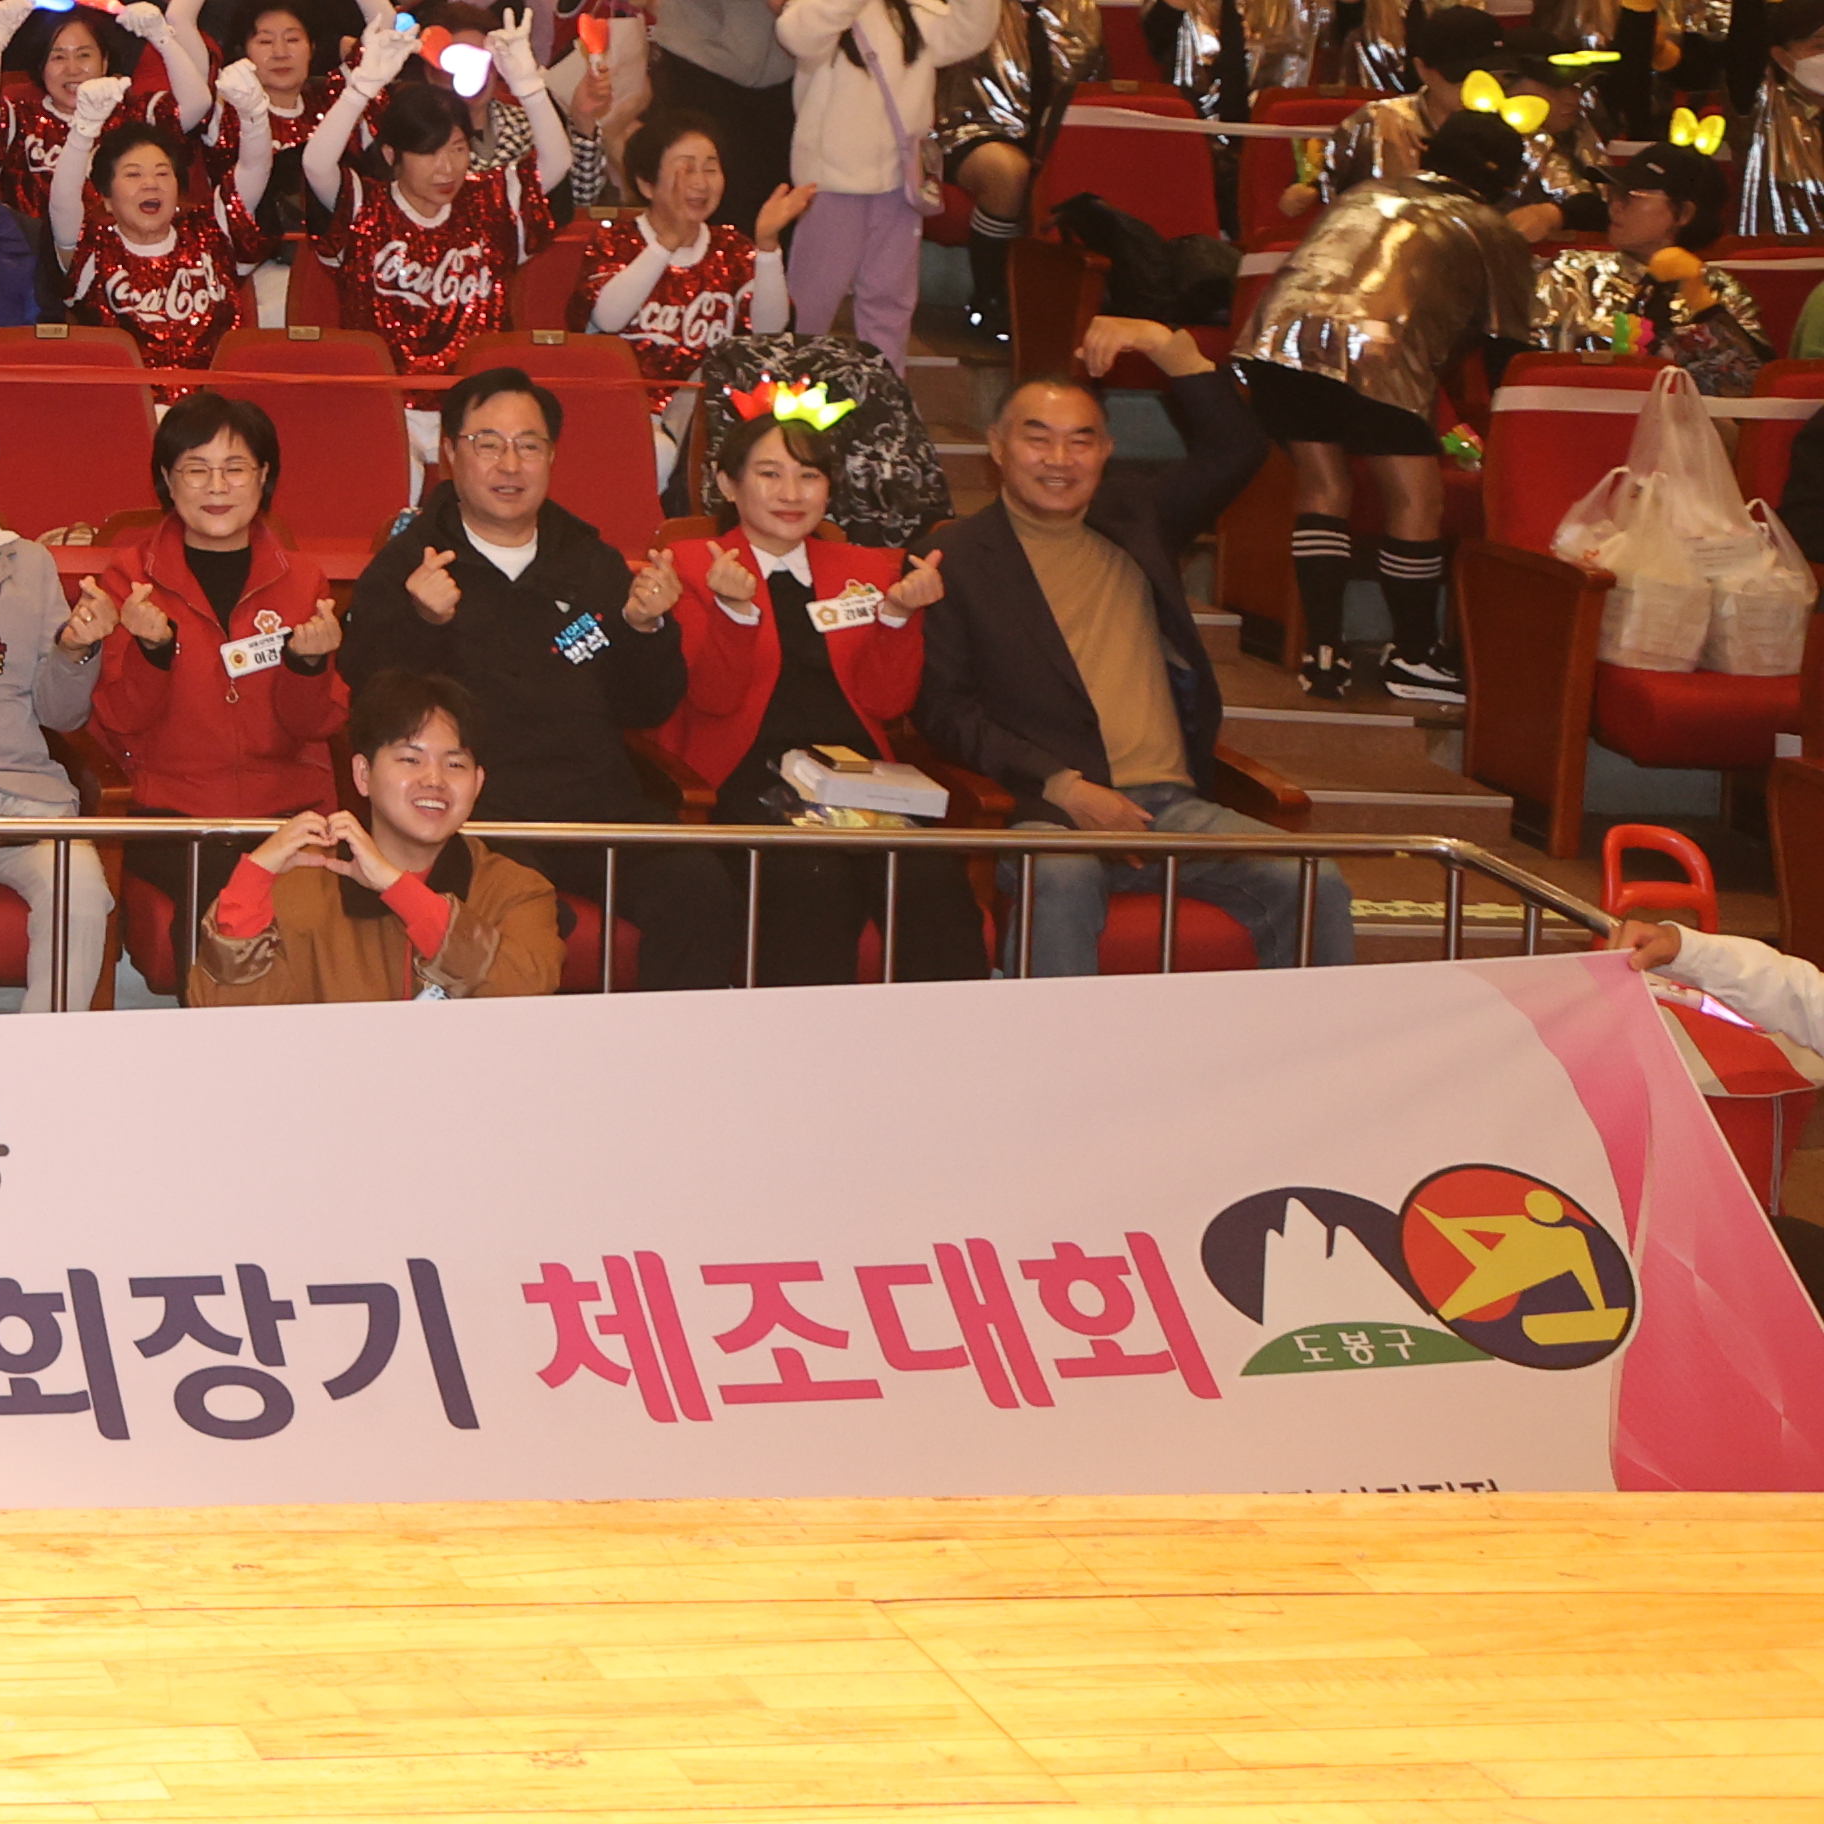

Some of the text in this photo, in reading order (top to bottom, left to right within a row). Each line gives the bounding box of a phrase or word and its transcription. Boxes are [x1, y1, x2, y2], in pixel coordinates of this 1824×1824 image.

[253, 647, 279, 665] 이경
[519, 1229, 1225, 1425] 체조대회
[1292, 1328, 1417, 1366] 도봉구
